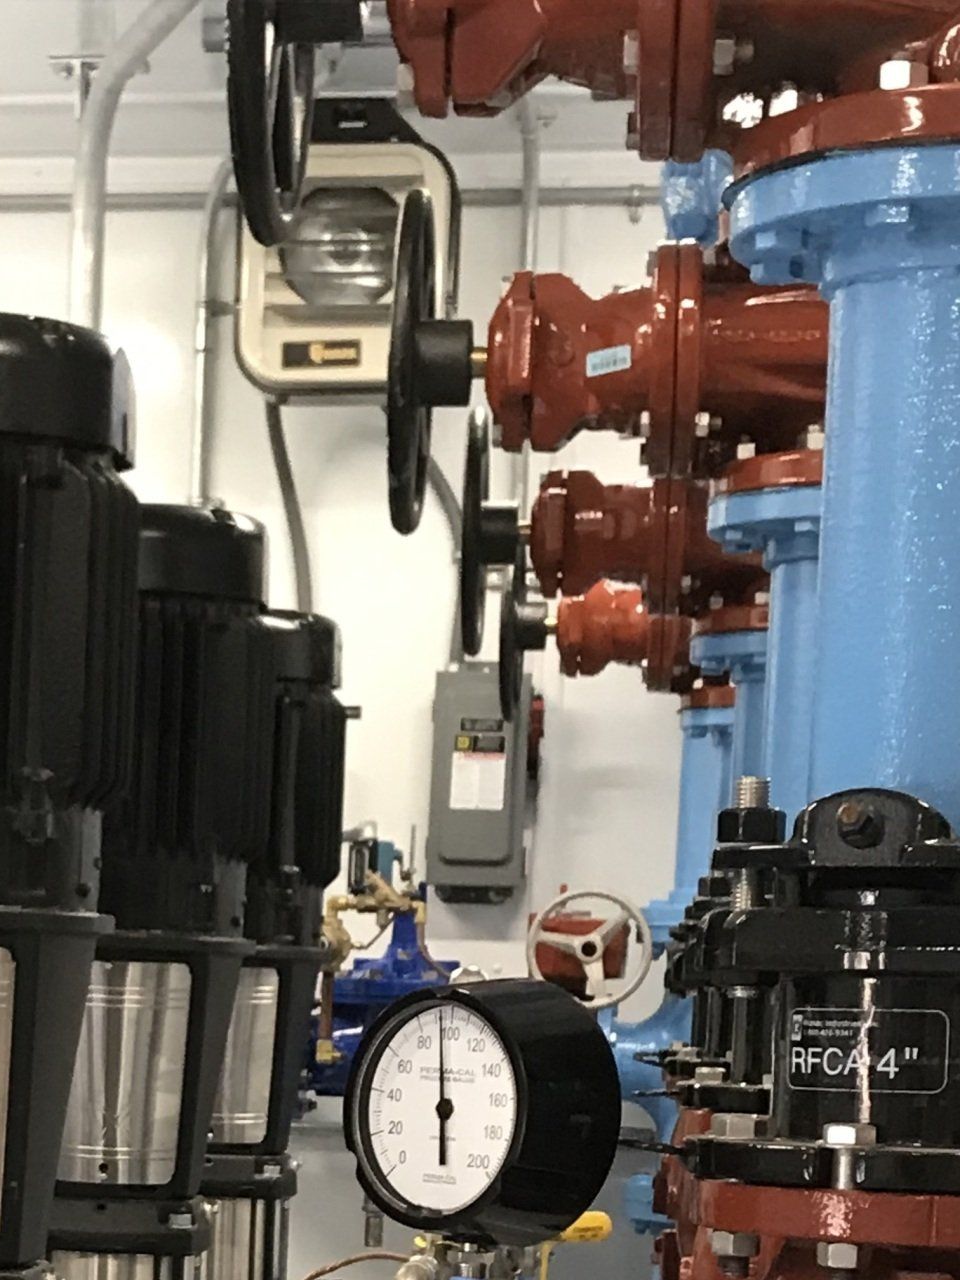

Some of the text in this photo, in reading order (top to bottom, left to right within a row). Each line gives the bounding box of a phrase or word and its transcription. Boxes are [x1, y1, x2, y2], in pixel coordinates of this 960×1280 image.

[442, 1026, 460, 1041] 100
[417, 1035, 432, 1050] 80
[467, 1038, 486, 1053] 120
[397, 1058, 413, 1074] 60
[791, 1046, 862, 1075] RFCA
[481, 1063, 502, 1078] 140
[387, 1088, 402, 1102] 40
[489, 1092, 508, 1108] 160
[388, 1120, 403, 1135] 20
[484, 1124, 503, 1140] 180
[398, 1150, 407, 1165] 0
[466, 1153, 490, 1170] 200
